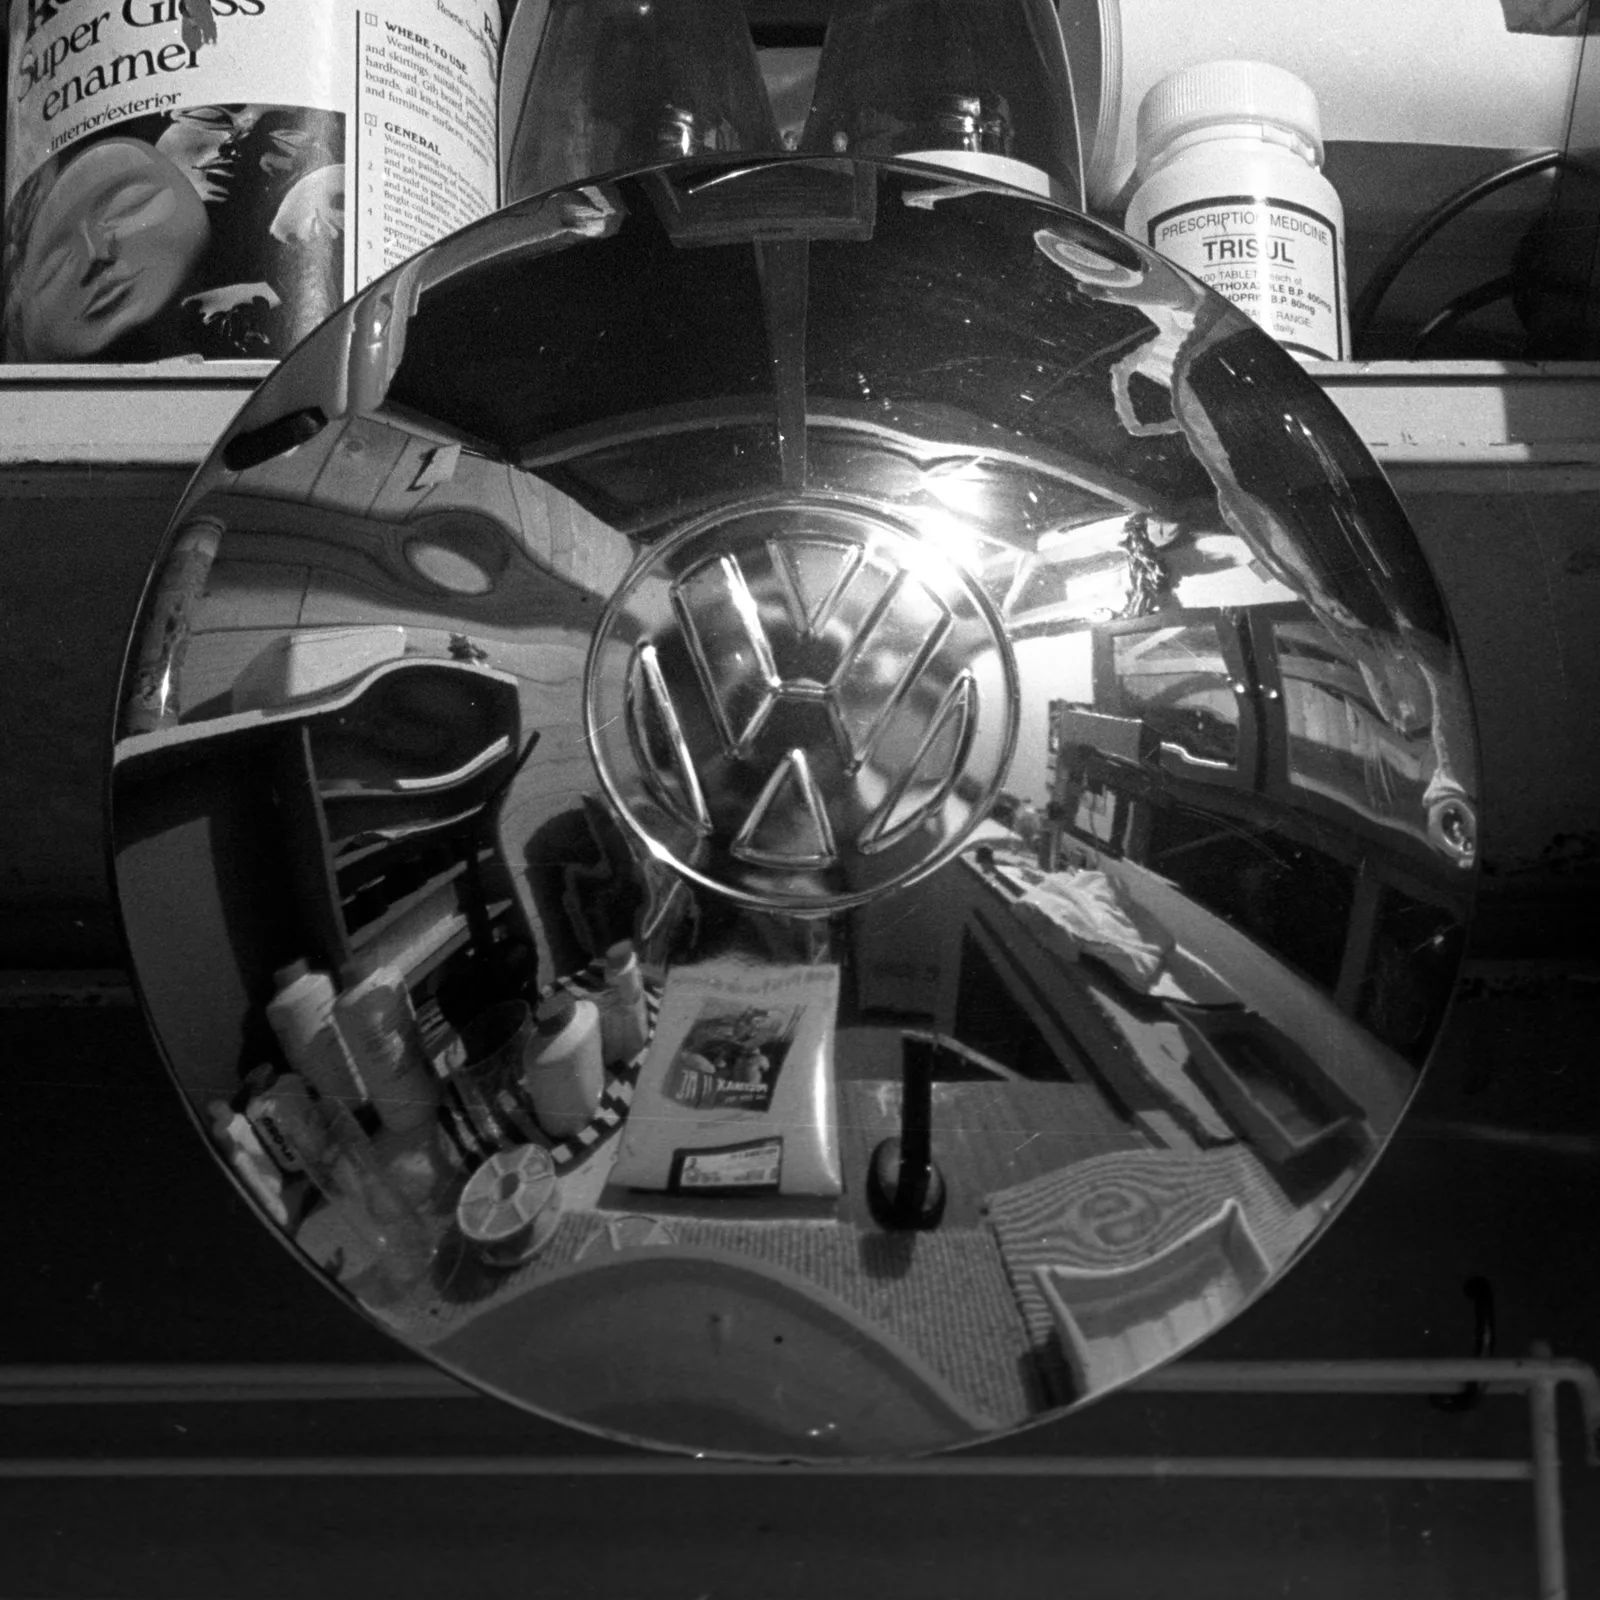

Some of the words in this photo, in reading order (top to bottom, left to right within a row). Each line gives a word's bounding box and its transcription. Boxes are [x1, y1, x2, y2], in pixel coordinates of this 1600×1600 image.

[17, 11, 110, 104] Super
[122, 0, 265, 28] Gss
[365, 42, 385, 56] and
[384, 21, 430, 49] WHERE
[432, 43, 447, 59] TO
[448, 53, 468, 75] USE
[365, 84, 385, 98] and
[50, 92, 182, 152] interior/exterior
[383, 120, 441, 157] GENERAL
[1162, 211, 1260, 241] PRESCRIPTIO
[1270, 213, 1328, 246] MEDICINE
